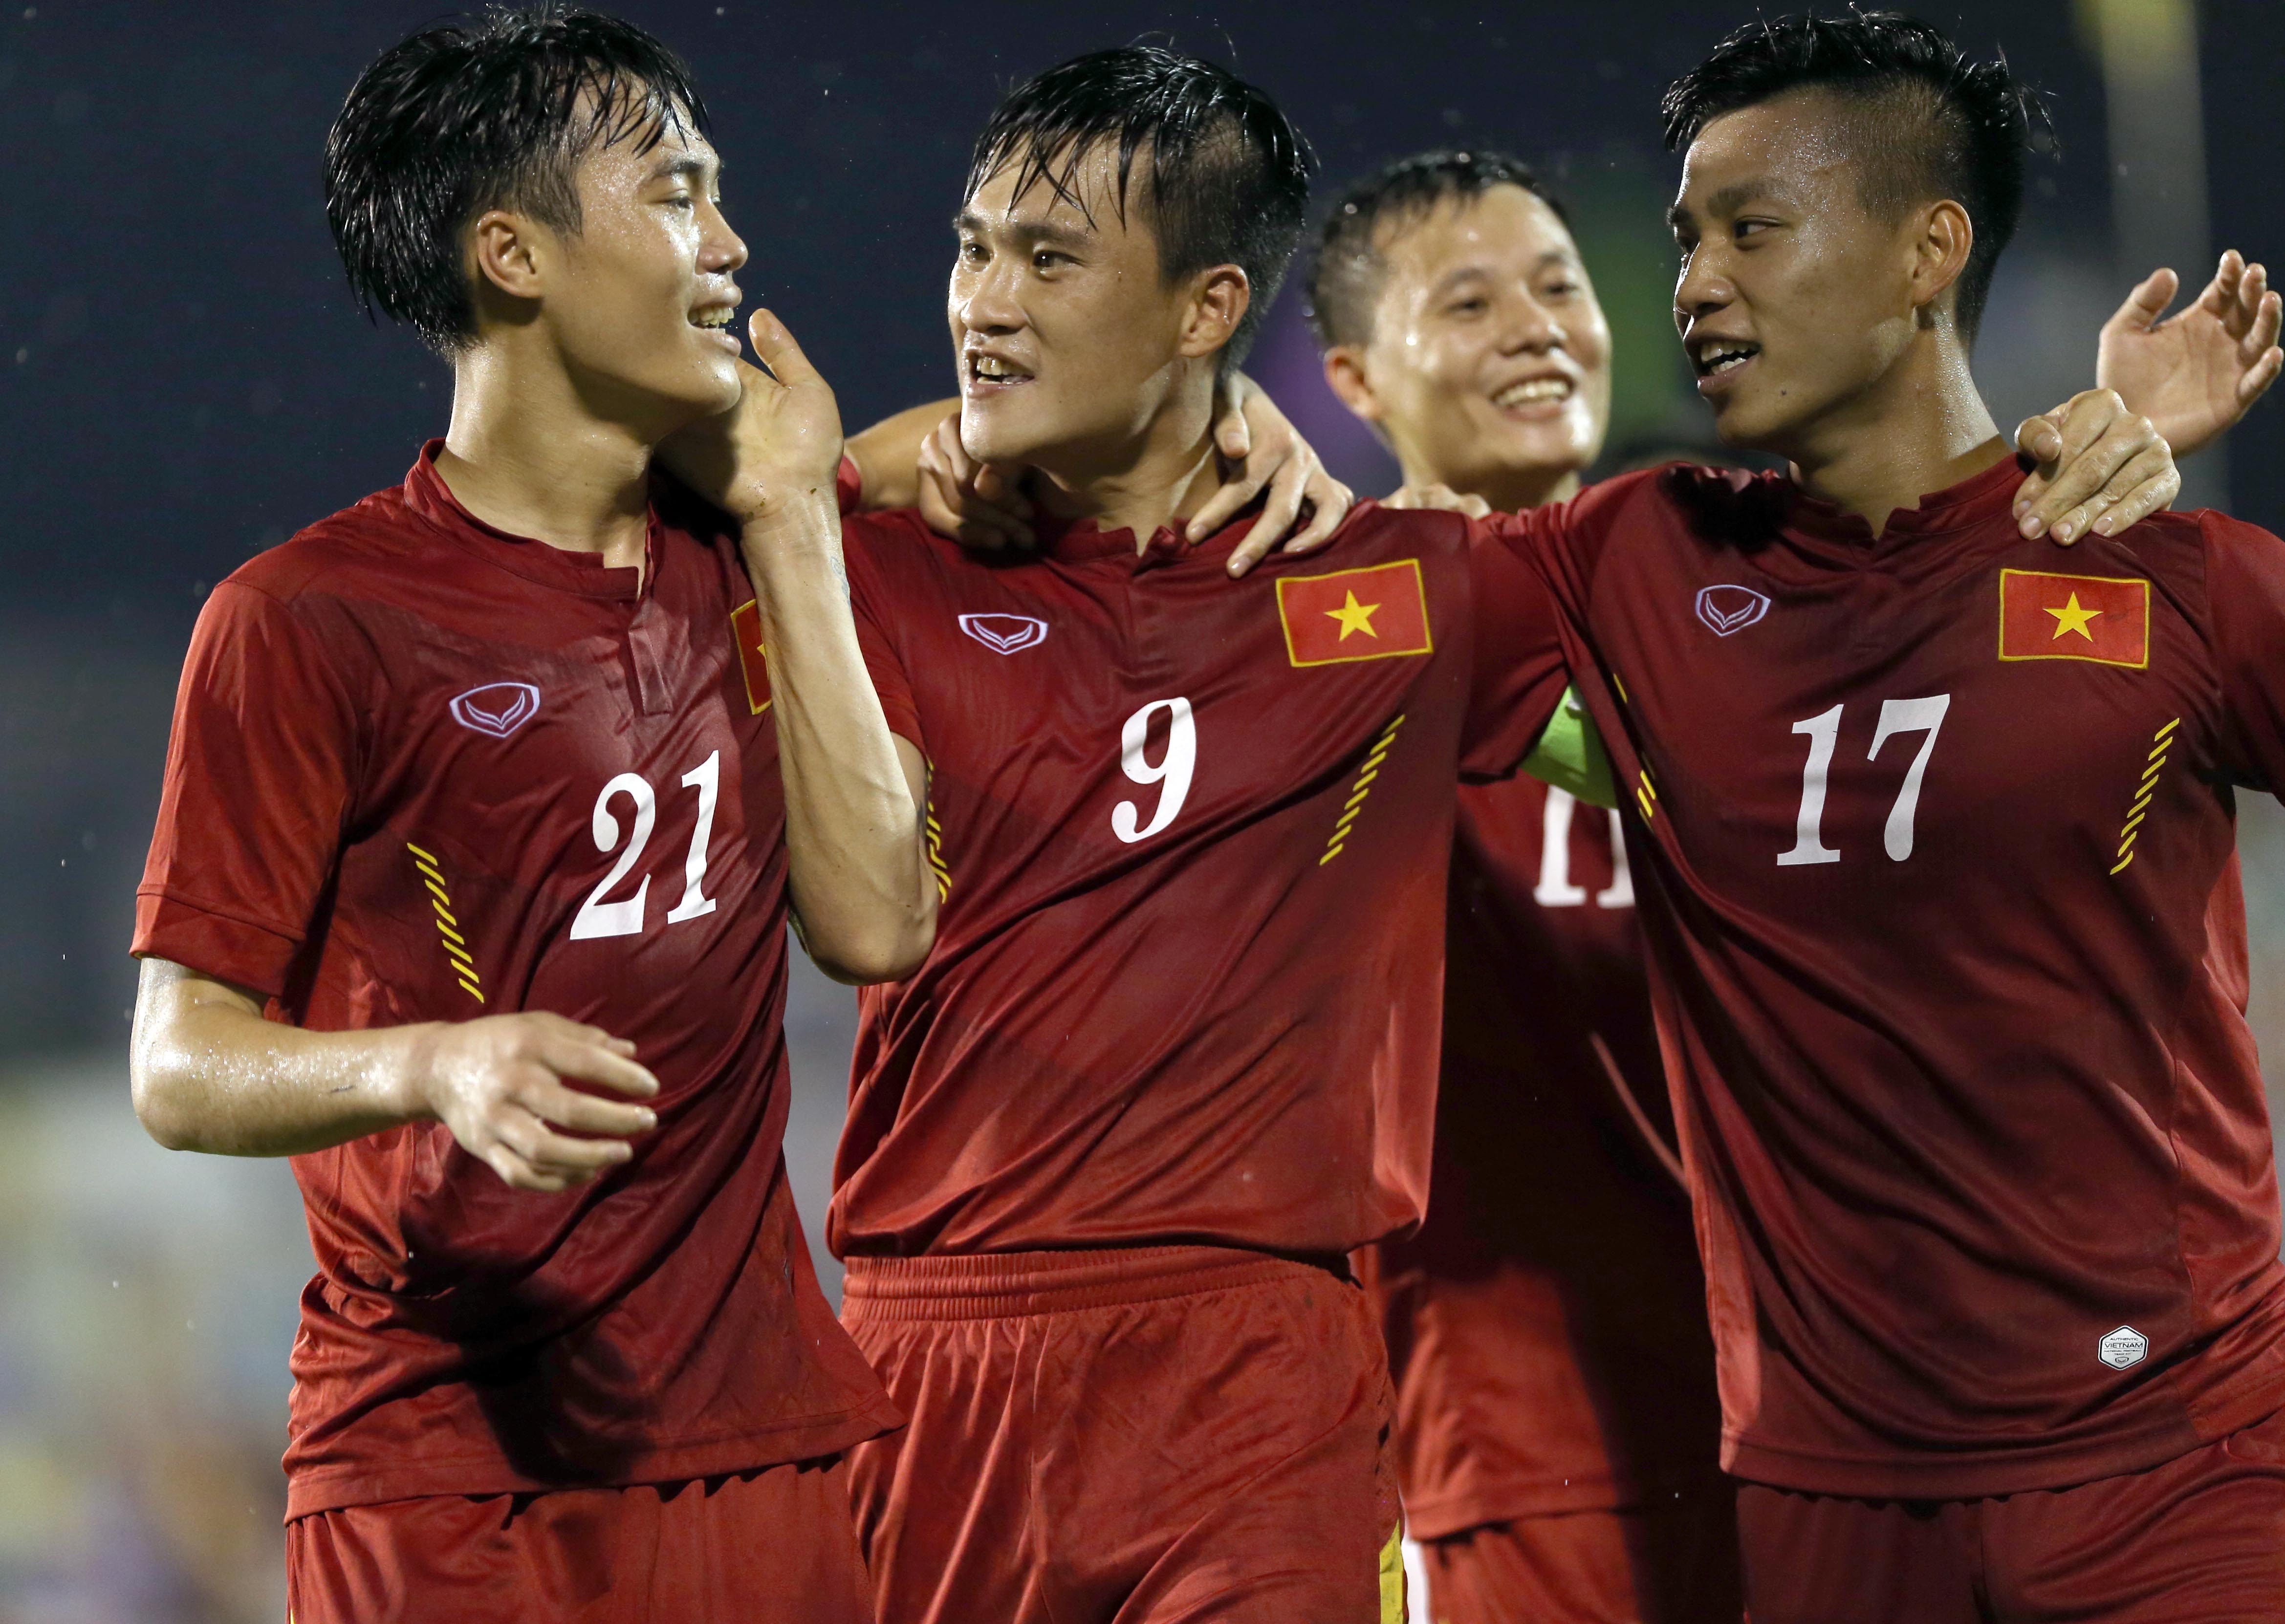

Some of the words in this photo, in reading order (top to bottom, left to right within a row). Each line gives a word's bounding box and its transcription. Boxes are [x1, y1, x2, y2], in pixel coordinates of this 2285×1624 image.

[569, 749, 719, 940] 21
[1111, 696, 1197, 844] 9
[1777, 693, 1950, 866] 17
